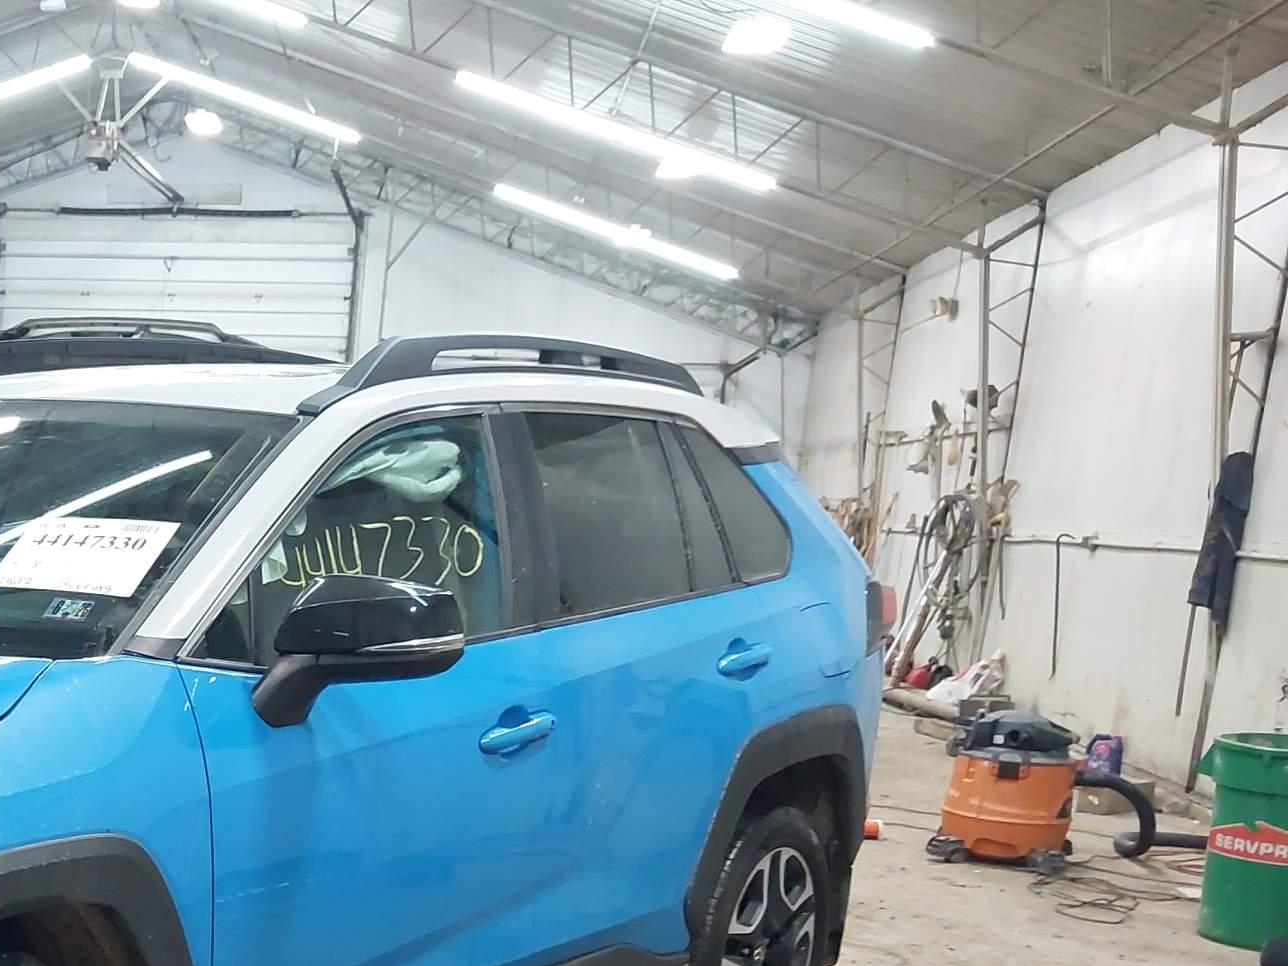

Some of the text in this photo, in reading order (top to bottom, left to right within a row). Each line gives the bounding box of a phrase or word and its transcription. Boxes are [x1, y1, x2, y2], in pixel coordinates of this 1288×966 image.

[32, 533, 147, 551] 44147330
[280, 516, 484, 587] 44147330
[1215, 833, 1288, 858] SERVPR
